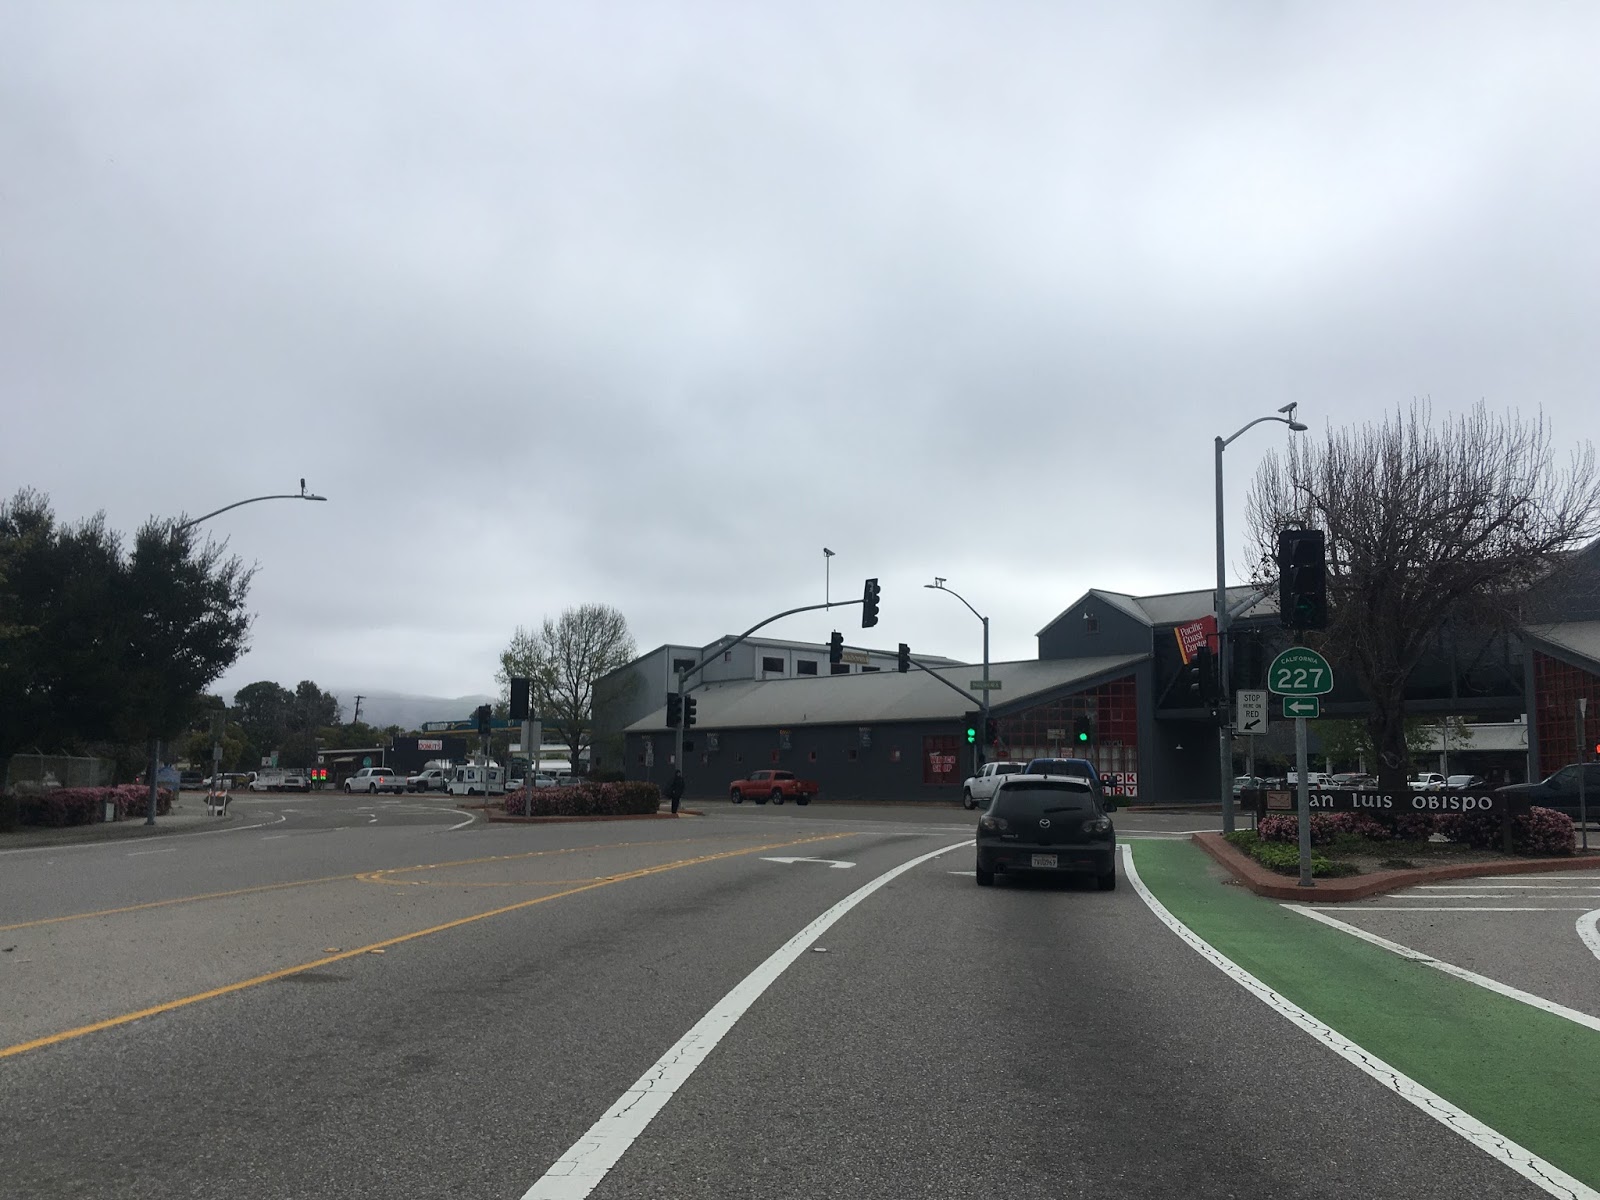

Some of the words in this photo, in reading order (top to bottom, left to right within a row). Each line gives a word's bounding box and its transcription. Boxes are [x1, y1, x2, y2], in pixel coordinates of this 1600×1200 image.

[1180, 622, 1204, 637] Pacific
[1182, 631, 1204, 645] Coast
[1280, 656, 1318, 665] CALIFORNIA
[1277, 668, 1324, 688] 227
[1243, 694, 1261, 702] STOP
[1245, 710, 1260, 718] RED
[1309, 794, 1335, 808] an
